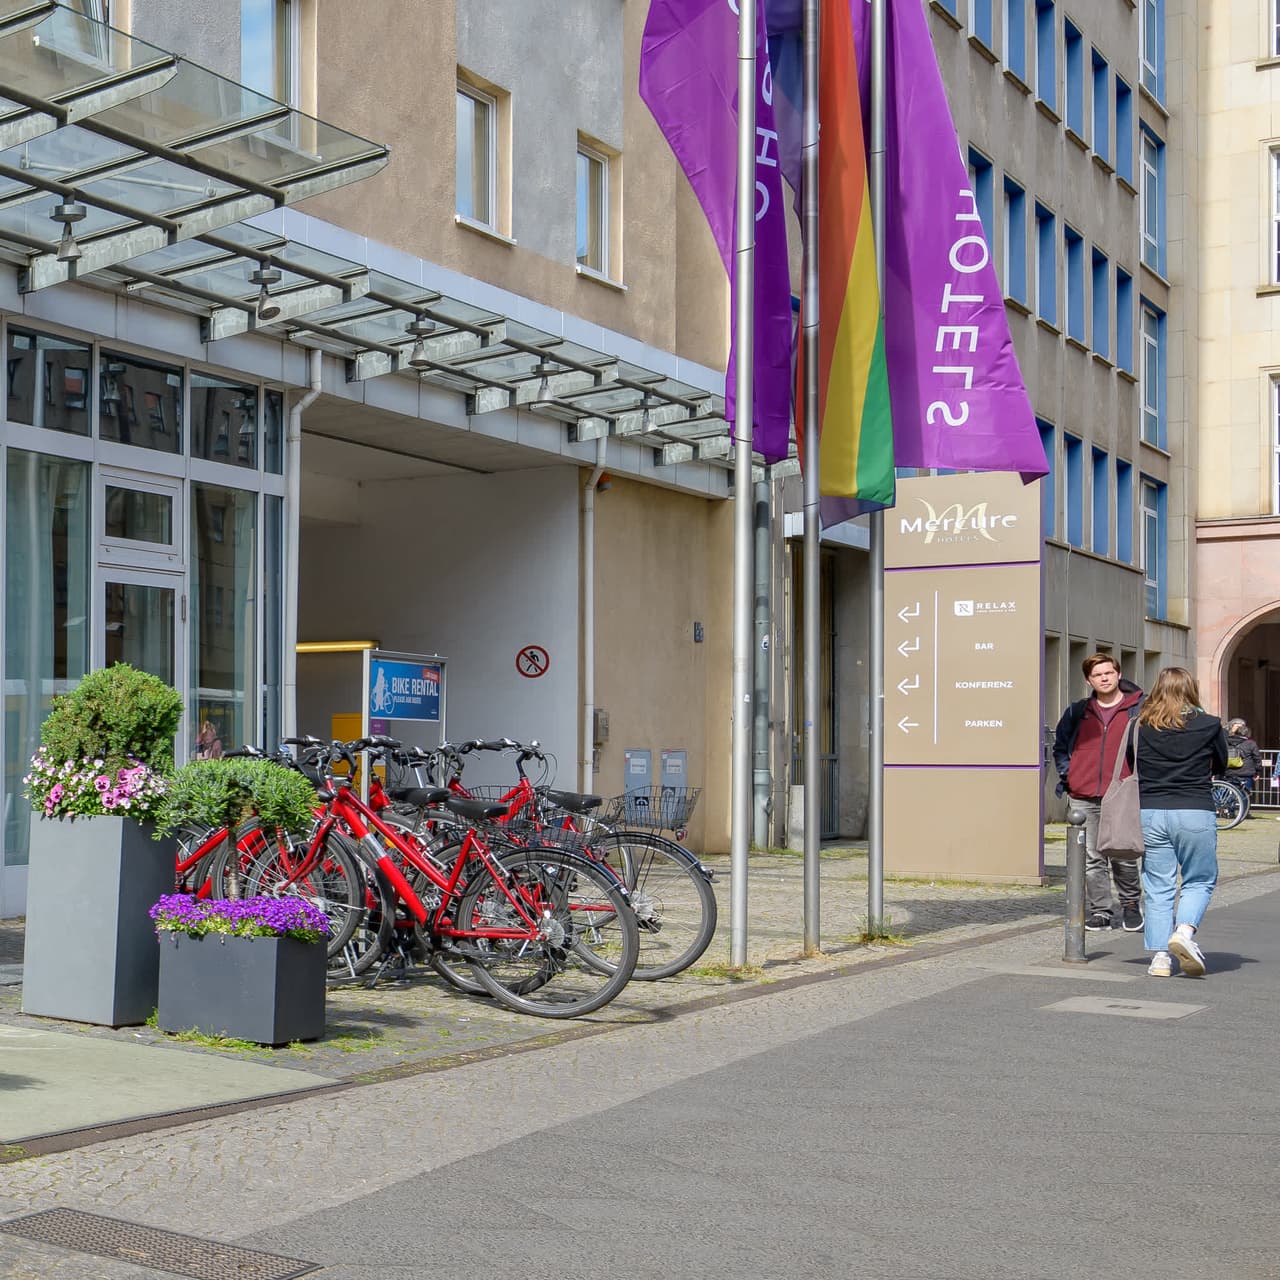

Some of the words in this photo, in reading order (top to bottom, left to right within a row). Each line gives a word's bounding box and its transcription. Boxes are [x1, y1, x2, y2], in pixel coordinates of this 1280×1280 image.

[900, 514, 1017, 534] Mercure
[976, 601, 1016, 609] RELAX
[975, 642, 994, 650] BAR
[392, 677, 409, 694] BIKE
[412, 679, 438, 696] RENTAL
[955, 681, 1014, 689] KONFERENZ
